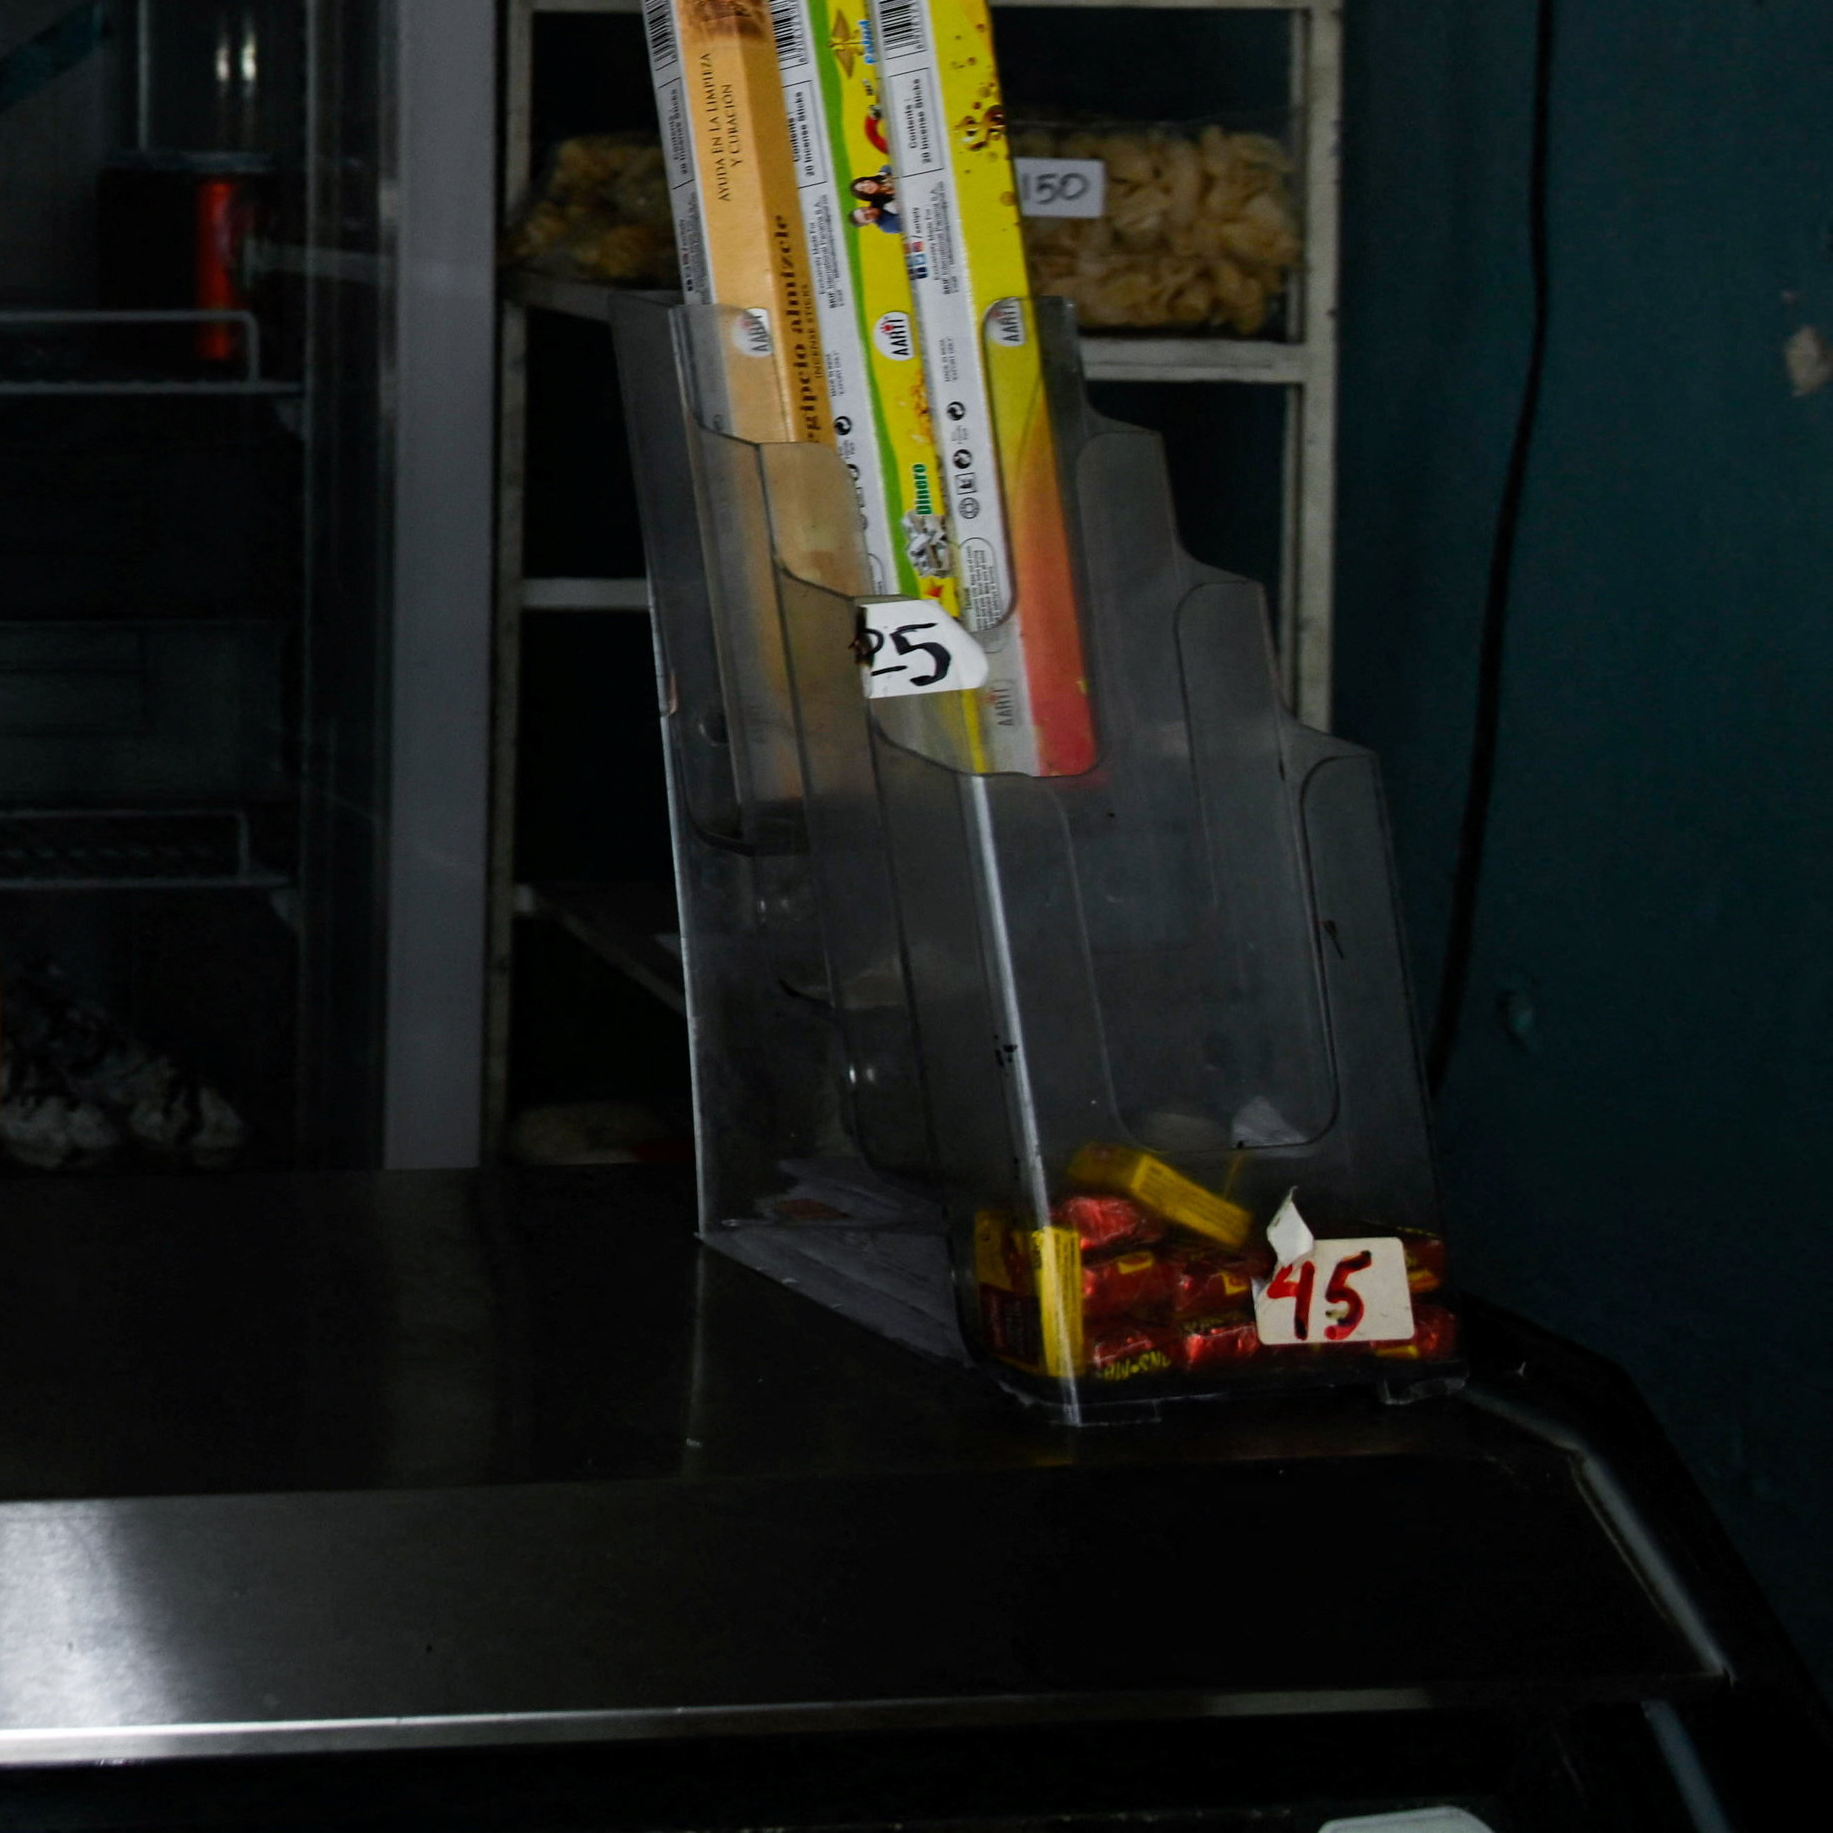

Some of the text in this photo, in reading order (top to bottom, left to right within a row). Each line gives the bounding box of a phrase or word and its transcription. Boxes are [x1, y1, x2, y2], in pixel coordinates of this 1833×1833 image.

[701, 53, 731, 202] AYUDA EN LA LIMPIEZA
[795, 91, 806, 122] Sticks
[905, 104, 918, 149] Contents
[912, 78, 931, 164] 20 Incense Sticks
[731, 159, 743, 167] Y
[801, 124, 813, 163] Incense
[1021, 170, 1090, 205] 150
[773, 214, 804, 334] almizcle
[888, 318, 910, 356] AARTI
[996, 297, 1020, 343] AARTI
[807, 329, 823, 379] INCENSE
[910, 463, 933, 515] Dinero
[995, 687, 1015, 727] AARTI
[1266, 1249, 1373, 1341] 45
